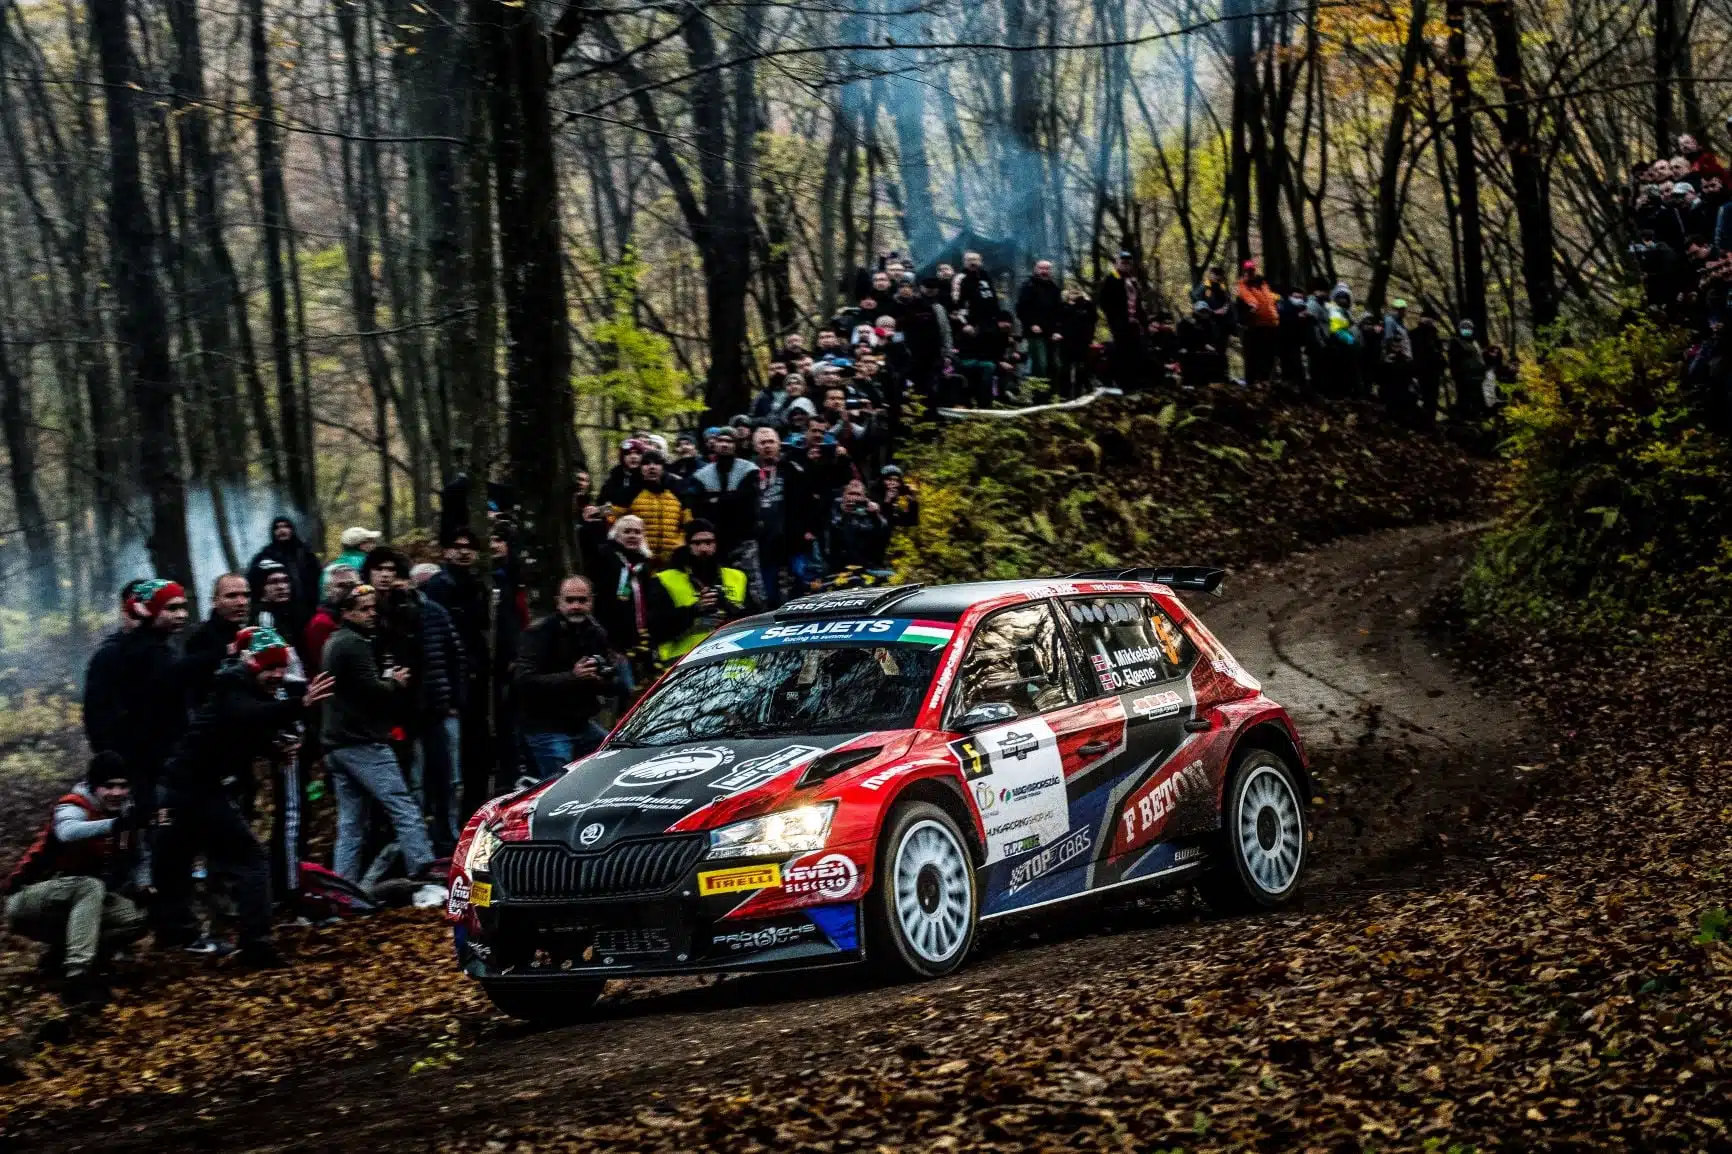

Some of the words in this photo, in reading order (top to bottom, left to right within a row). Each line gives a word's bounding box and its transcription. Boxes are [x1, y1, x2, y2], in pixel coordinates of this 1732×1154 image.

[760, 620, 895, 640] SEAJETS
[1113, 646, 1162, 667] Mikkelsen
[1112, 672, 1126, 687] O.
[962, 743, 982, 774] 5
[1123, 807, 1136, 843] F
[1022, 848, 1052, 880] TOP
[1059, 829, 1091, 862] CARS
[705, 868, 773, 890] PIRELLI
